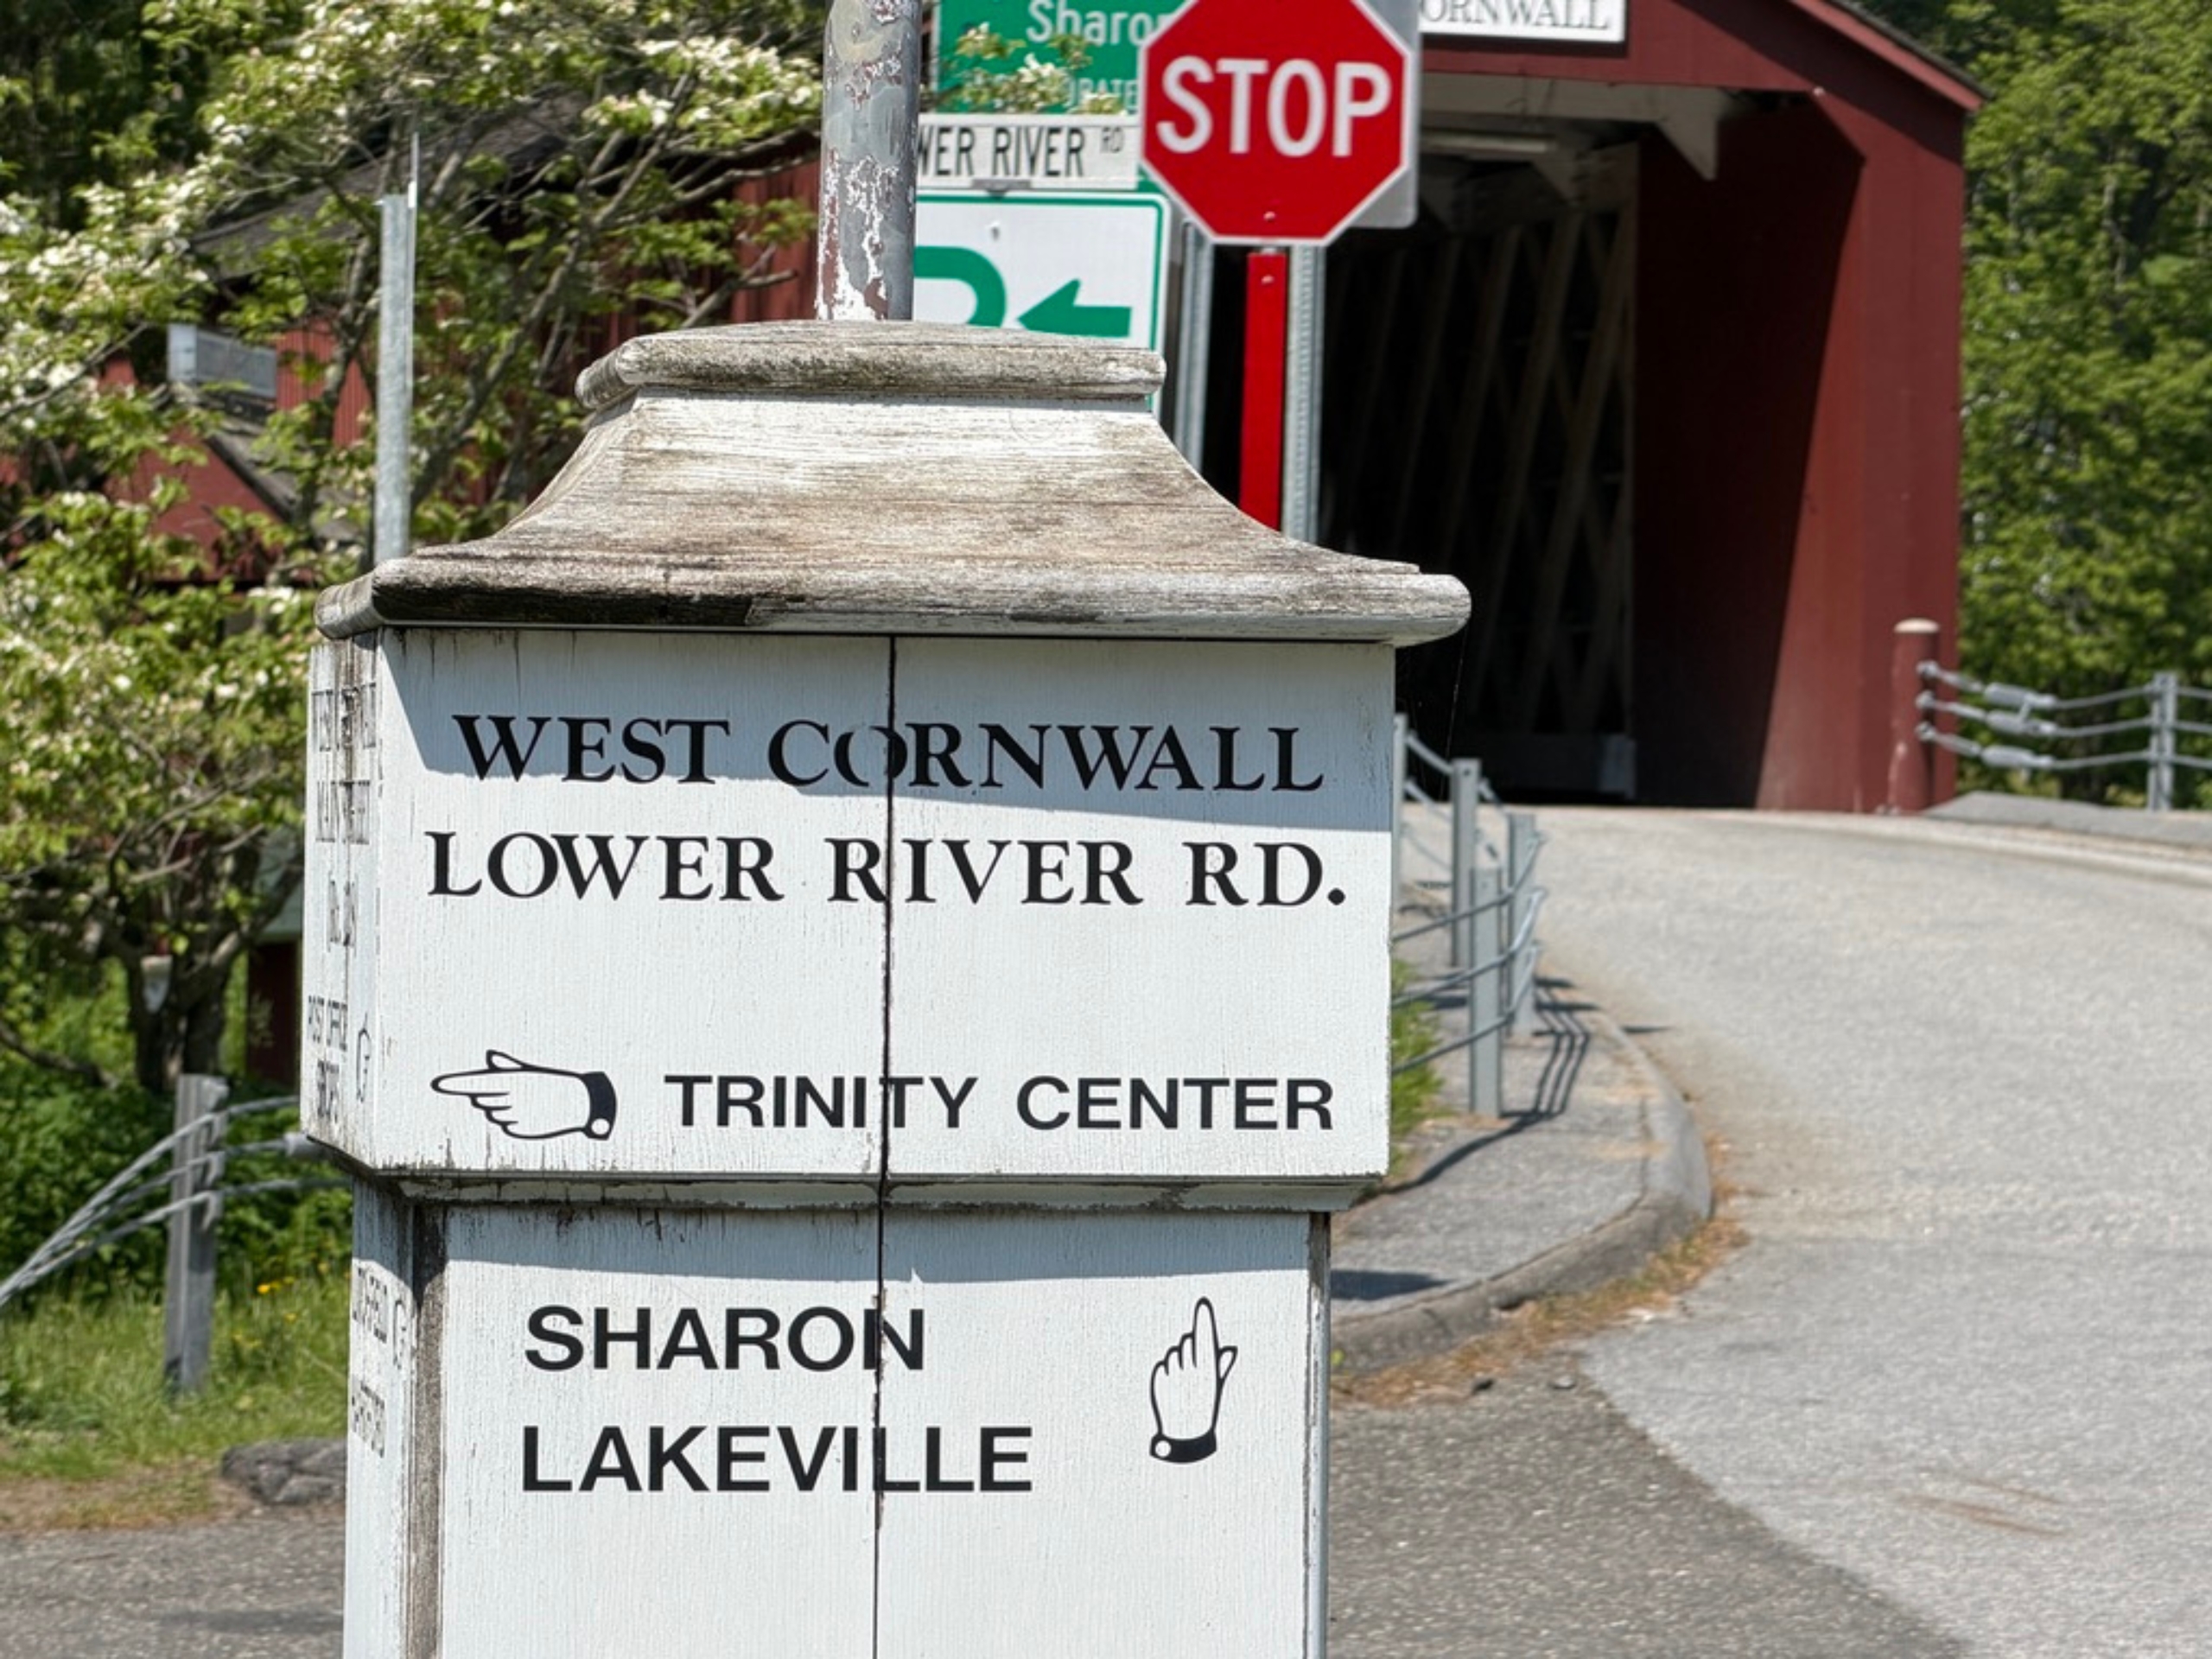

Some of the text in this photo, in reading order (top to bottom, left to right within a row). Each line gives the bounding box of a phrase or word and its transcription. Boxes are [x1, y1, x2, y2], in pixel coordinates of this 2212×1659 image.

[1419, 0, 1608, 29] ORNWALL
[1158, 56, 1391, 156] STOP
[918, 126, 1125, 177] WER RIVER RD
[452, 715, 730, 783] WEST
[768, 720, 1323, 791] CORNWALL
[425, 831, 1345, 906] LOWER RIVER RD.
[664, 1075, 1332, 1129] TRINITY CENTER
[525, 1306, 925, 1371] SHARON
[523, 1427, 1032, 1491] LAKEVILLE
